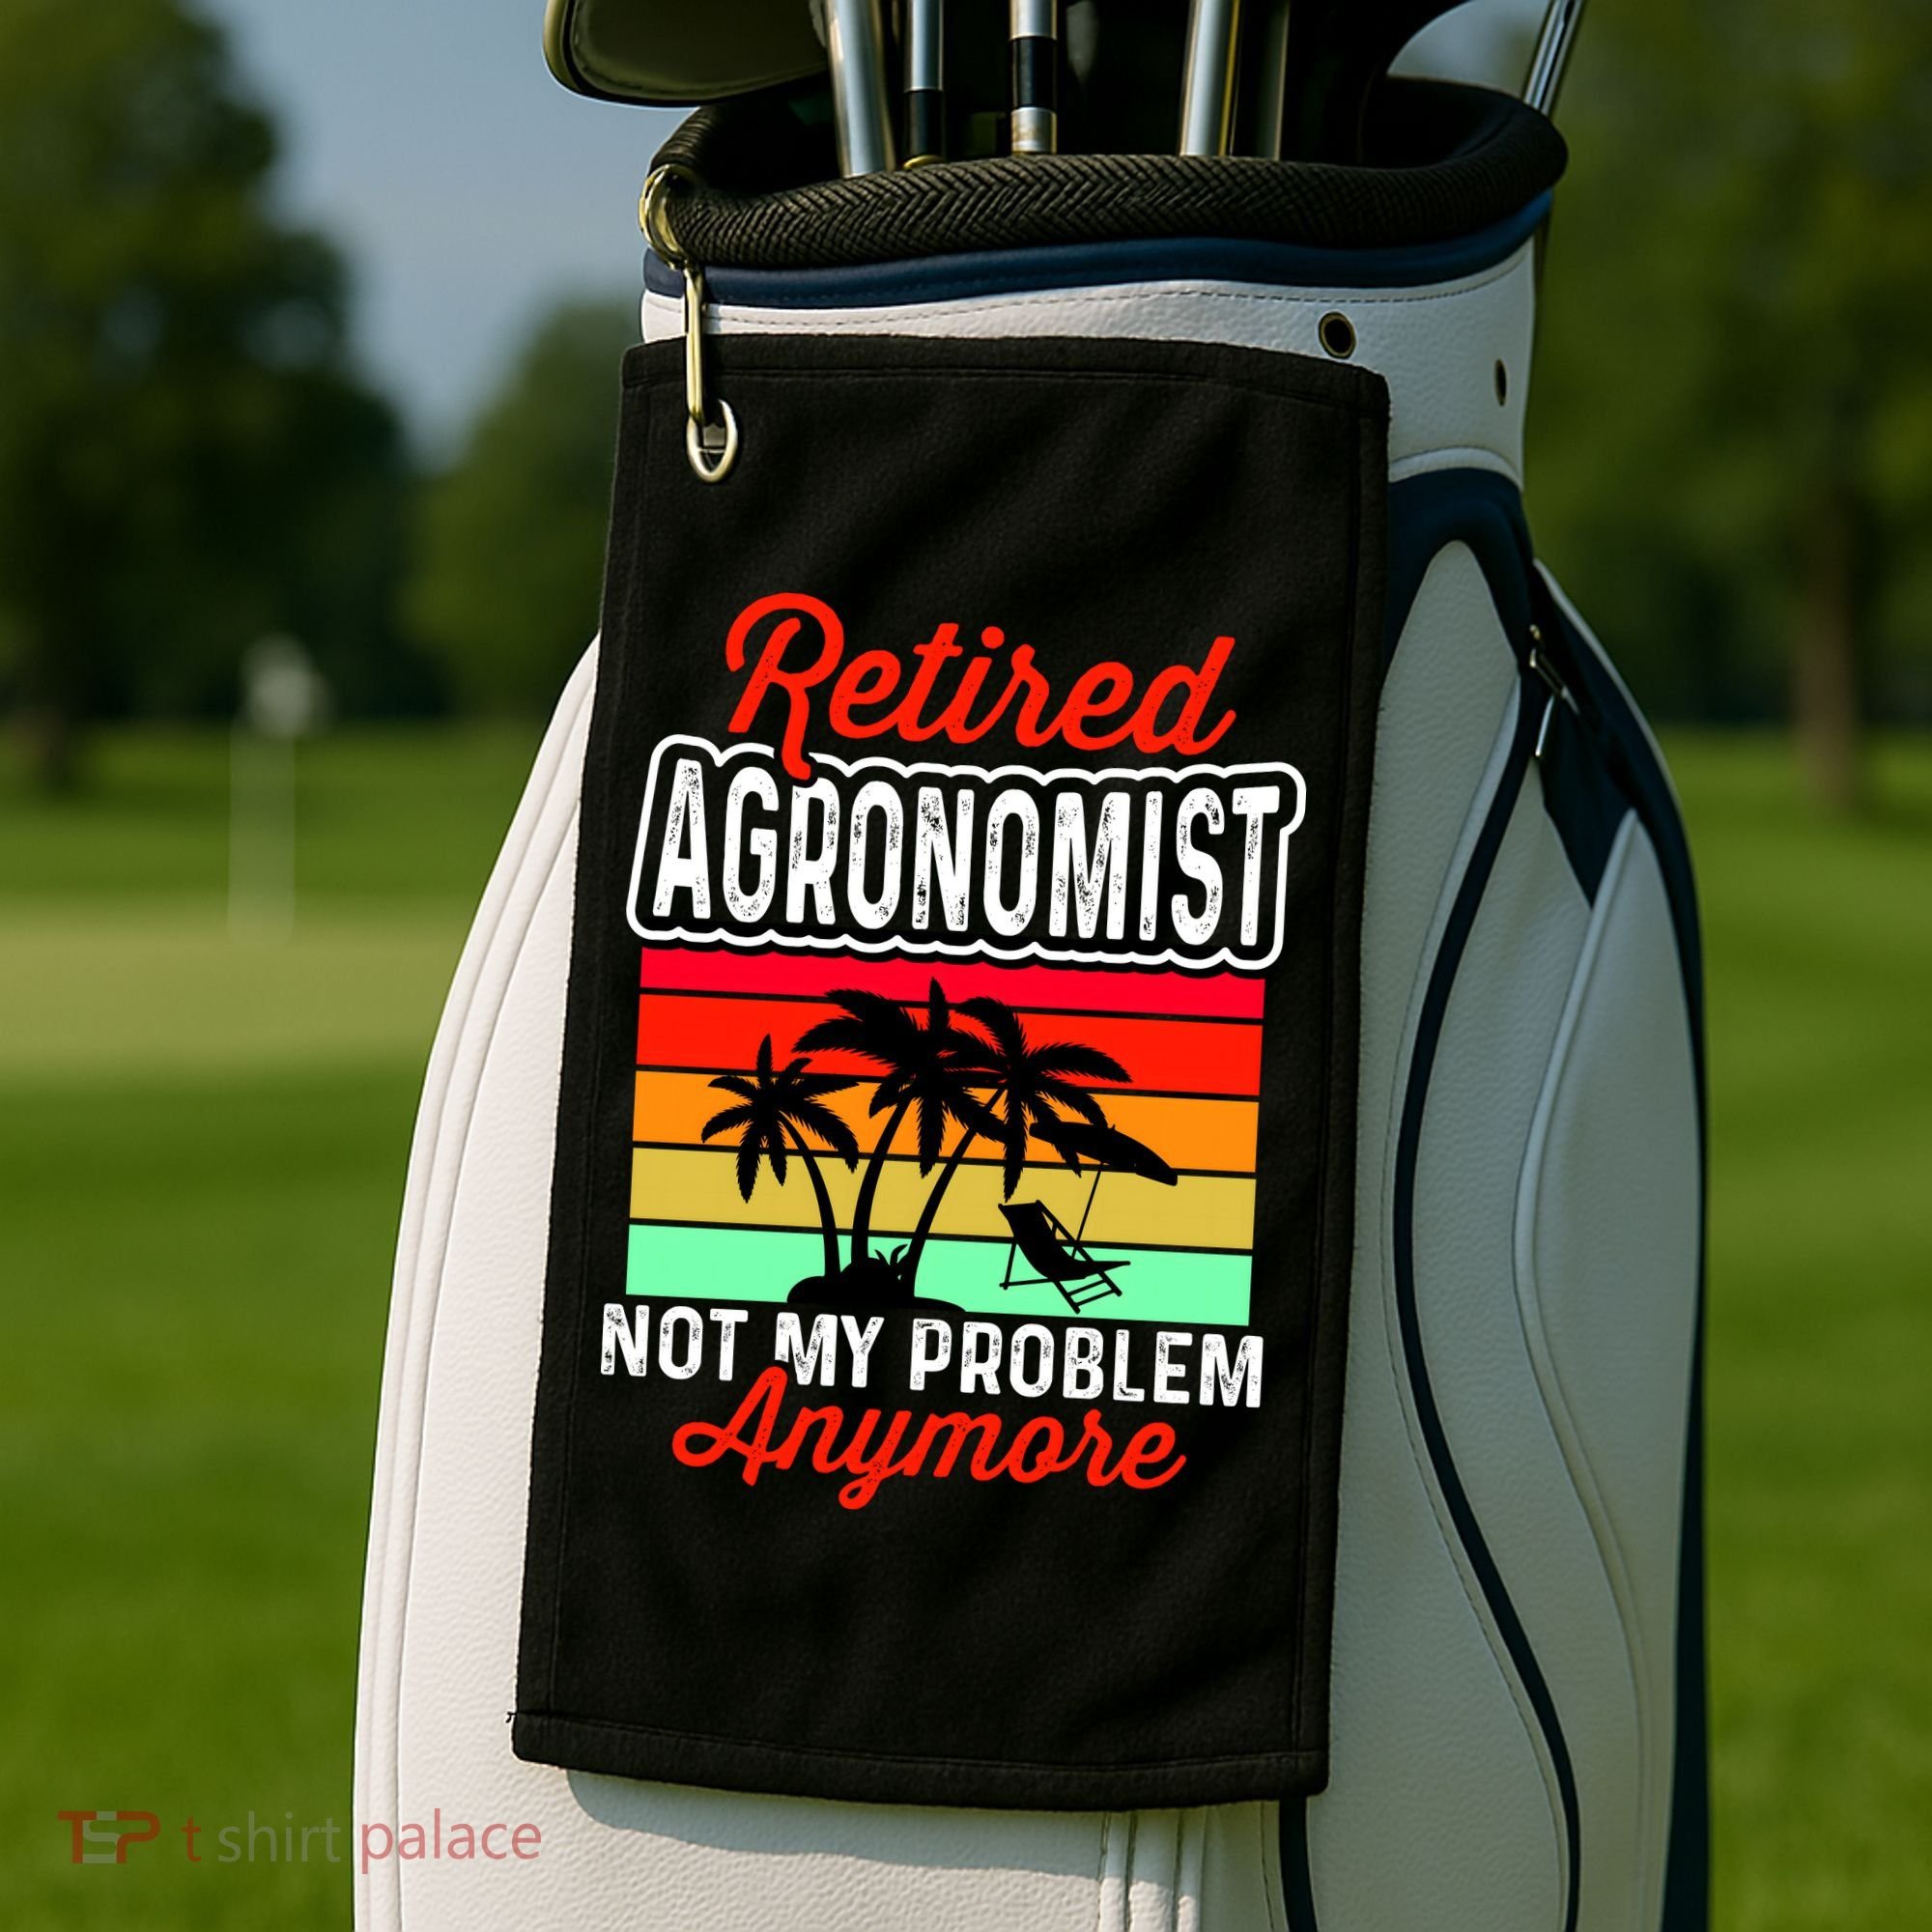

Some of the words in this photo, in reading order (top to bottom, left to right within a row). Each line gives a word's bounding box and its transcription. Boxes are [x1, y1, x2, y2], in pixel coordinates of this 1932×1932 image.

[725, 592, 1236, 780] Retired
[652, 758, 1280, 946] AGRONOMIST
[601, 1303, 749, 1381] NOT
[774, 1312, 884, 1388] MY
[909, 1318, 1264, 1407] PROBLEM
[672, 1366, 1186, 1510] Anymore
